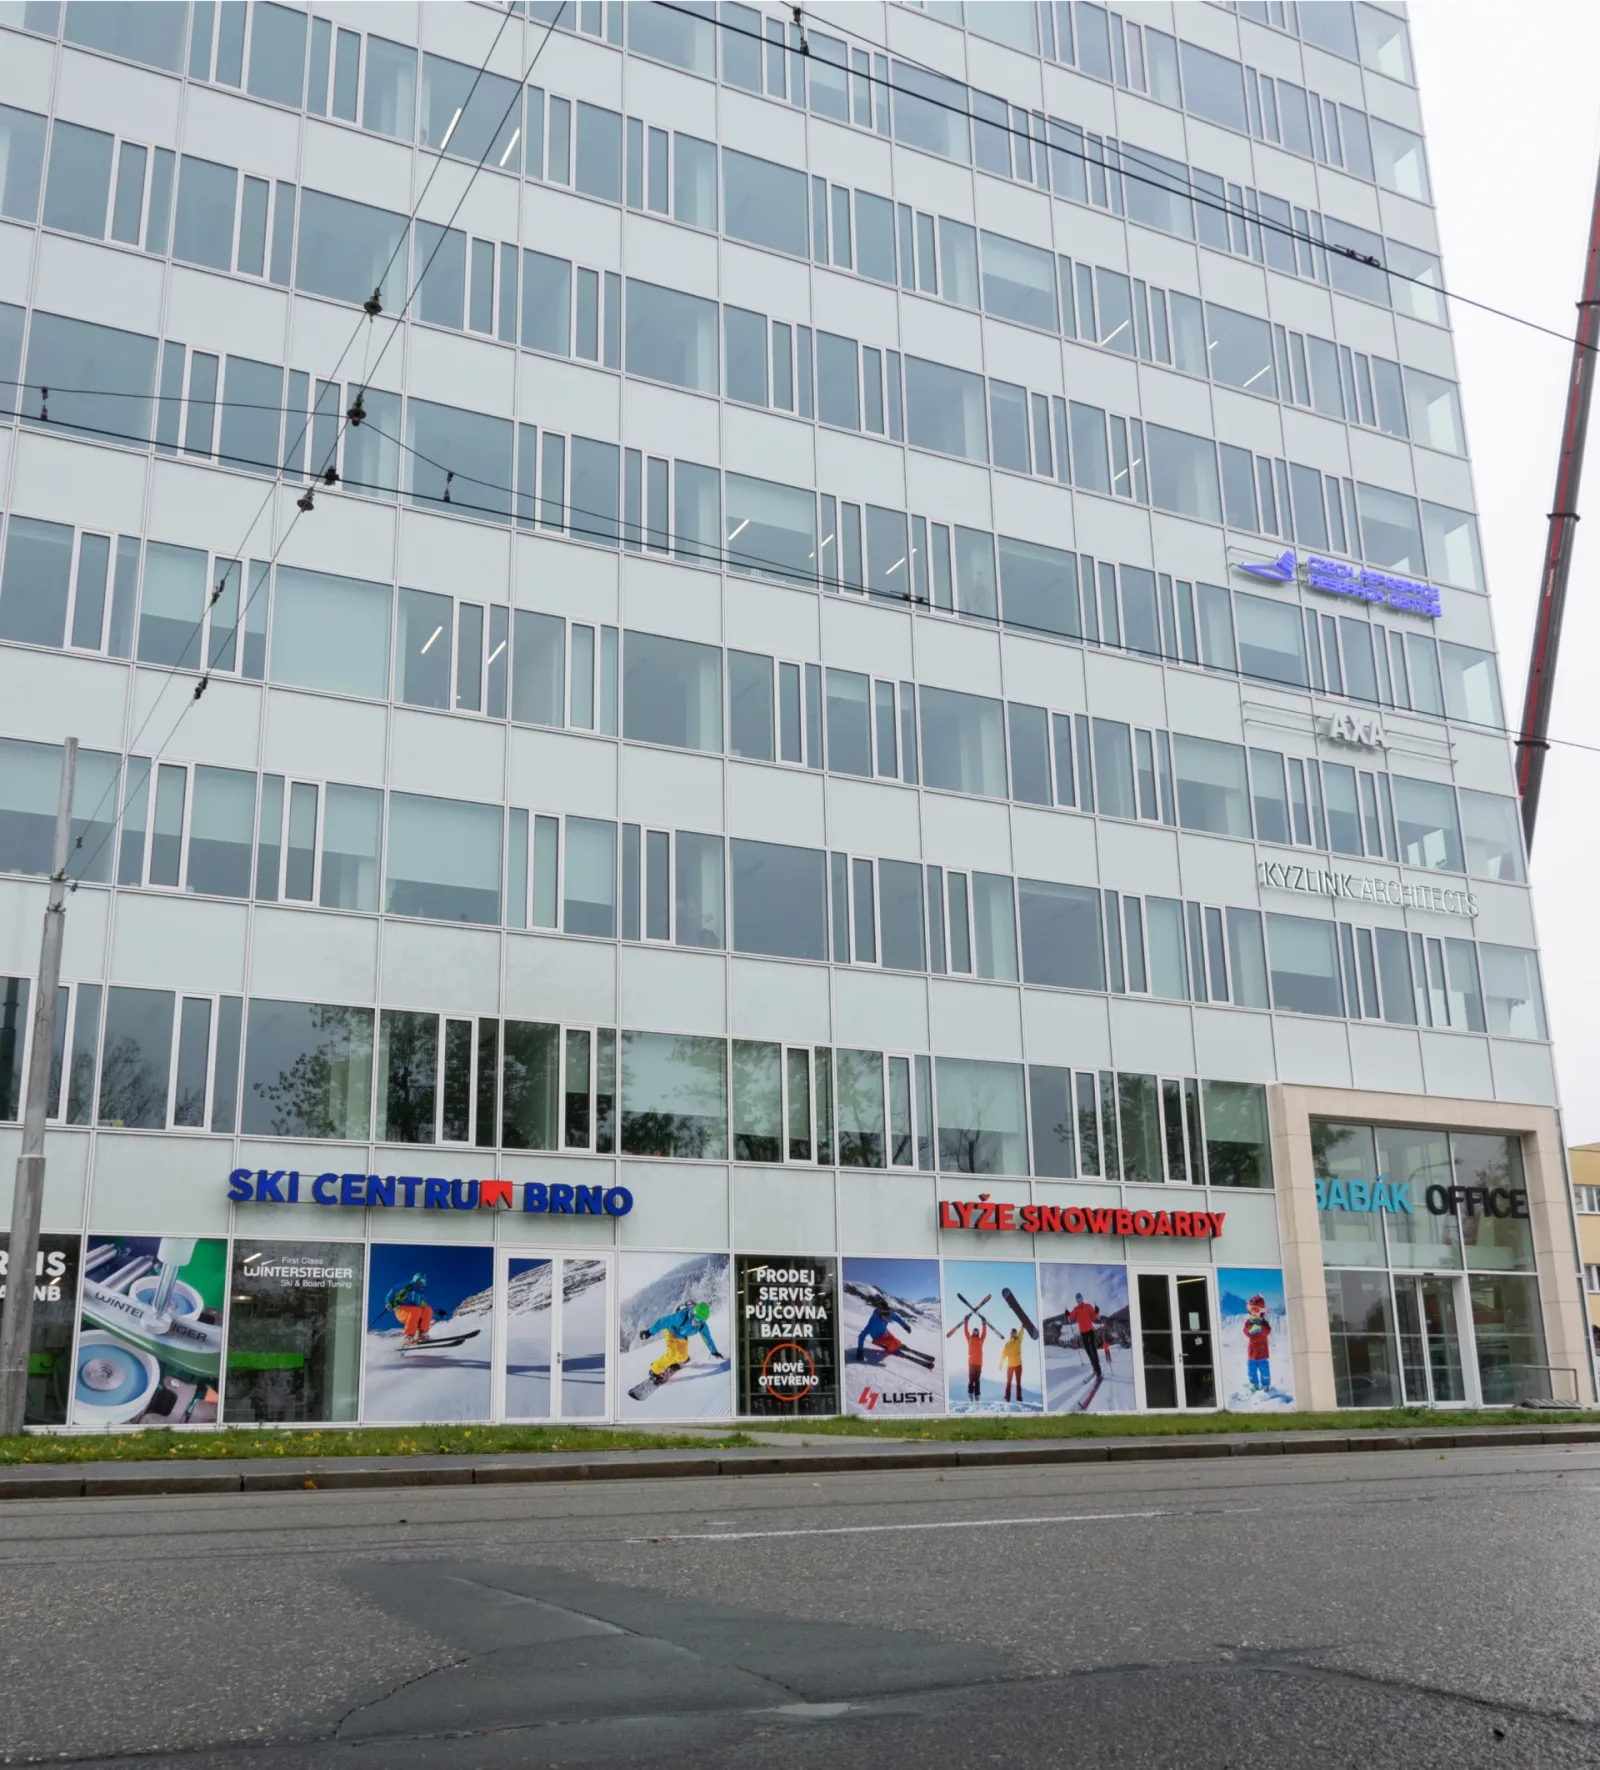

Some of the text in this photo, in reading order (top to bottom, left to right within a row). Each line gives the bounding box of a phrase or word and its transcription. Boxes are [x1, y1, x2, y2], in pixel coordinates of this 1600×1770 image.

[1308, 556, 1440, 602] CZECH AEROSPACE
[1308, 573, 1442, 617] RESEARCH CENTRE
[1329, 711, 1388, 749] AXA
[1262, 861, 1479, 917] KYZLINK ARCHITECTS
[228, 1168, 299, 1203] SKI
[523, 1182, 633, 1217] BRNO
[1425, 1184, 1530, 1219] OFFICE
[939, 1193, 1226, 1238] LYŽE SNOWBOARDY
[281, 1256, 324, 1265] First Class
[280, 1279, 353, 1290] Ski & Board Tuning
[756, 1269, 815, 1286] PRODEJ
[759, 1287, 813, 1301] SERVIS
[745, 1301, 828, 1322] PŮJČOVNA
[761, 1323, 814, 1338] BAZAR
[758, 1373, 819, 1387] OTEVŘENO
